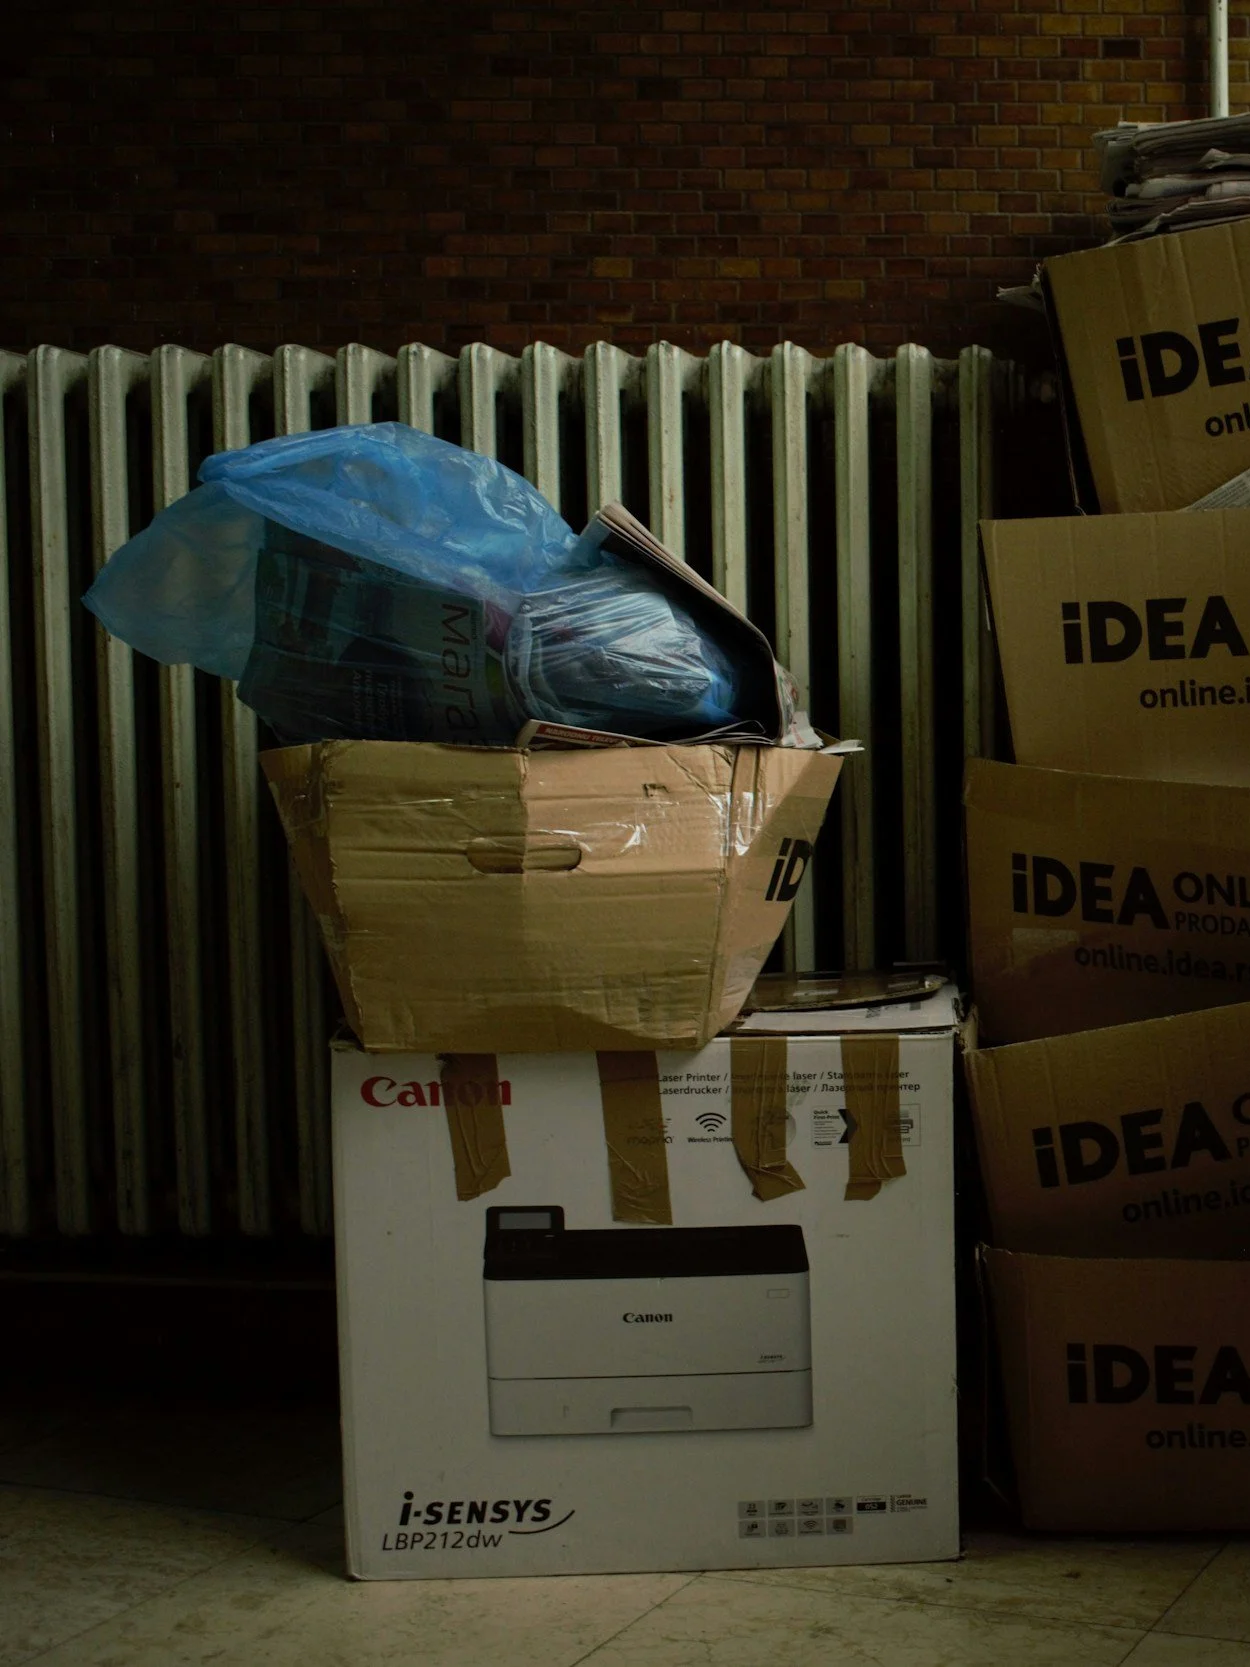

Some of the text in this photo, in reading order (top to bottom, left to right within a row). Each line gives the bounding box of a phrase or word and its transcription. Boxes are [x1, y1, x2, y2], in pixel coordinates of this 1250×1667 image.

[1061, 594, 1249, 665] iDEA
[1011, 852, 1171, 930] iDEA
[360, 1076, 512, 1108] Canon
[659, 1085, 723, 1095] Laserdrucker
[686, 1073, 720, 1082] Printer
[793, 1070, 817, 1081] laser
[1032, 1100, 1232, 1188] iDEA
[622, 1311, 674, 1325] Canon
[399, 1491, 553, 1526] i-SENSYS
[382, 1530, 504, 1551] LBP212dw
